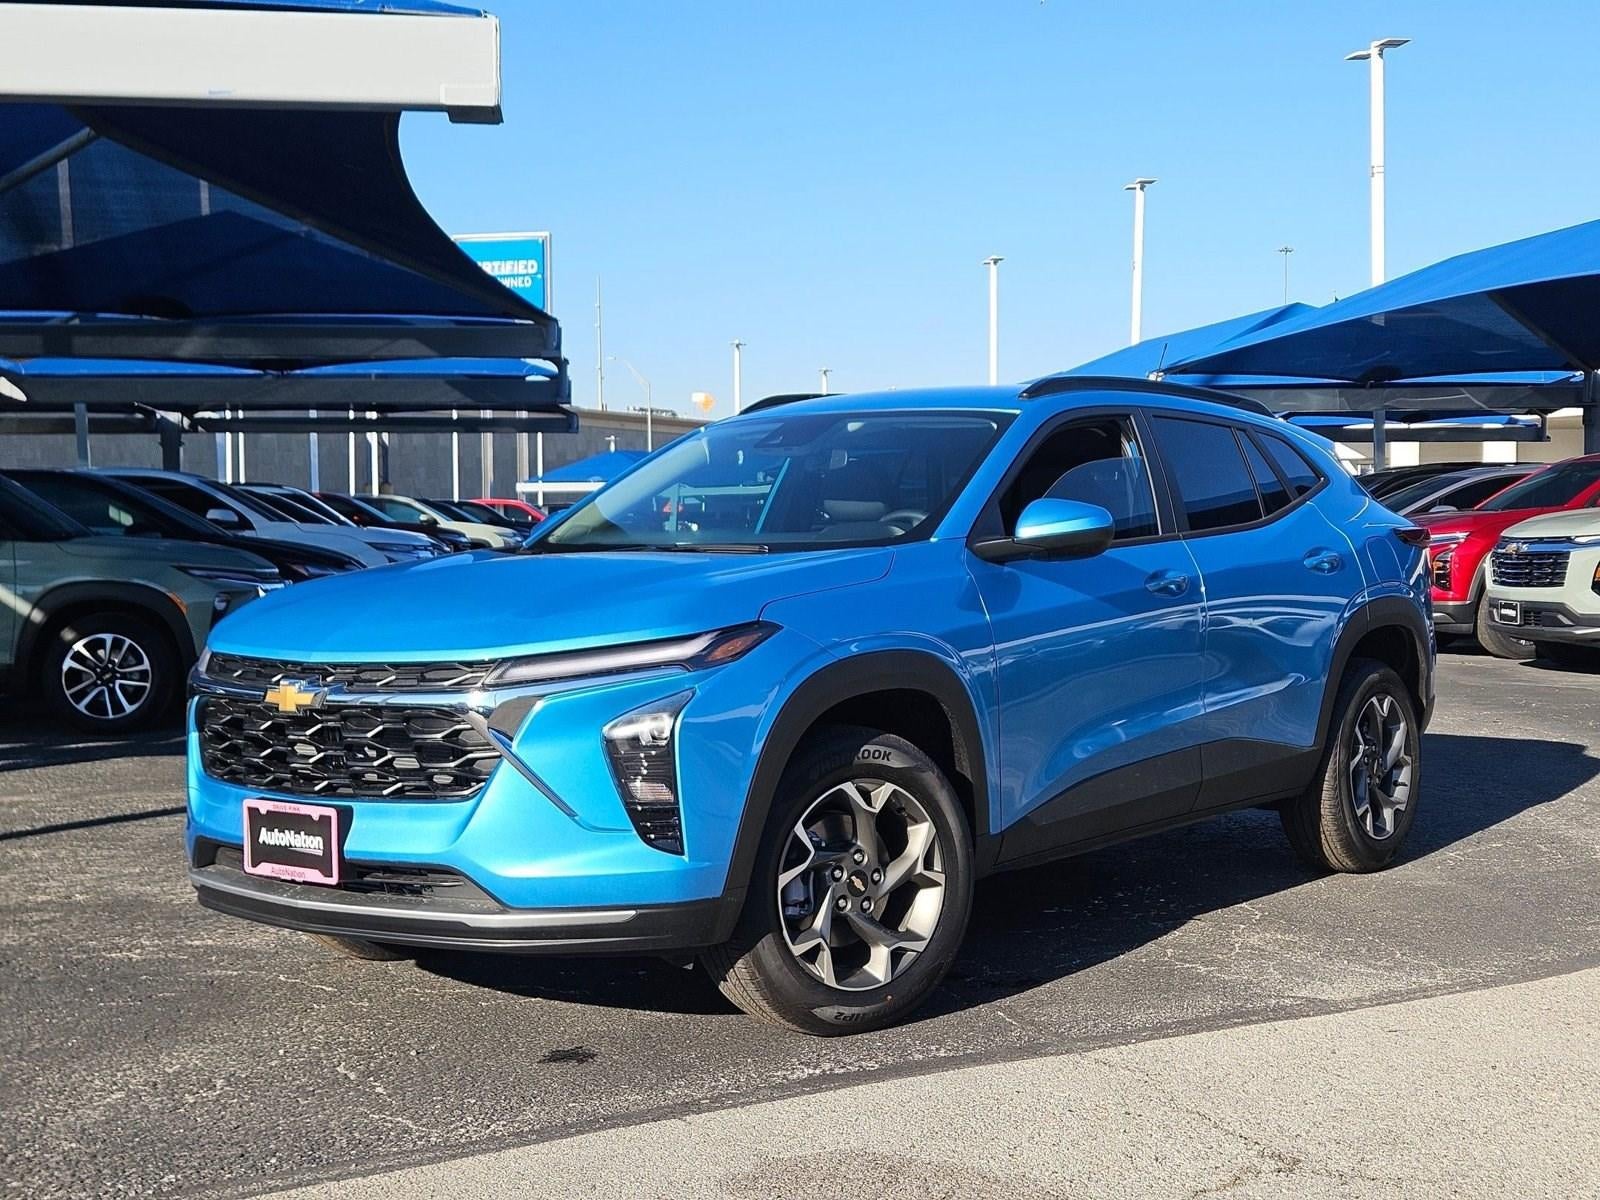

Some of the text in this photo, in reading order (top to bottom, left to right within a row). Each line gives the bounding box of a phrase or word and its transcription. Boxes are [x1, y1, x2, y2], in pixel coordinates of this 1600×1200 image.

[477, 259, 539, 276] RTIFIED
[497, 275, 532, 288] WNED
[258, 827, 324, 850] AutoNation
[271, 866, 306, 879] AutoNation
